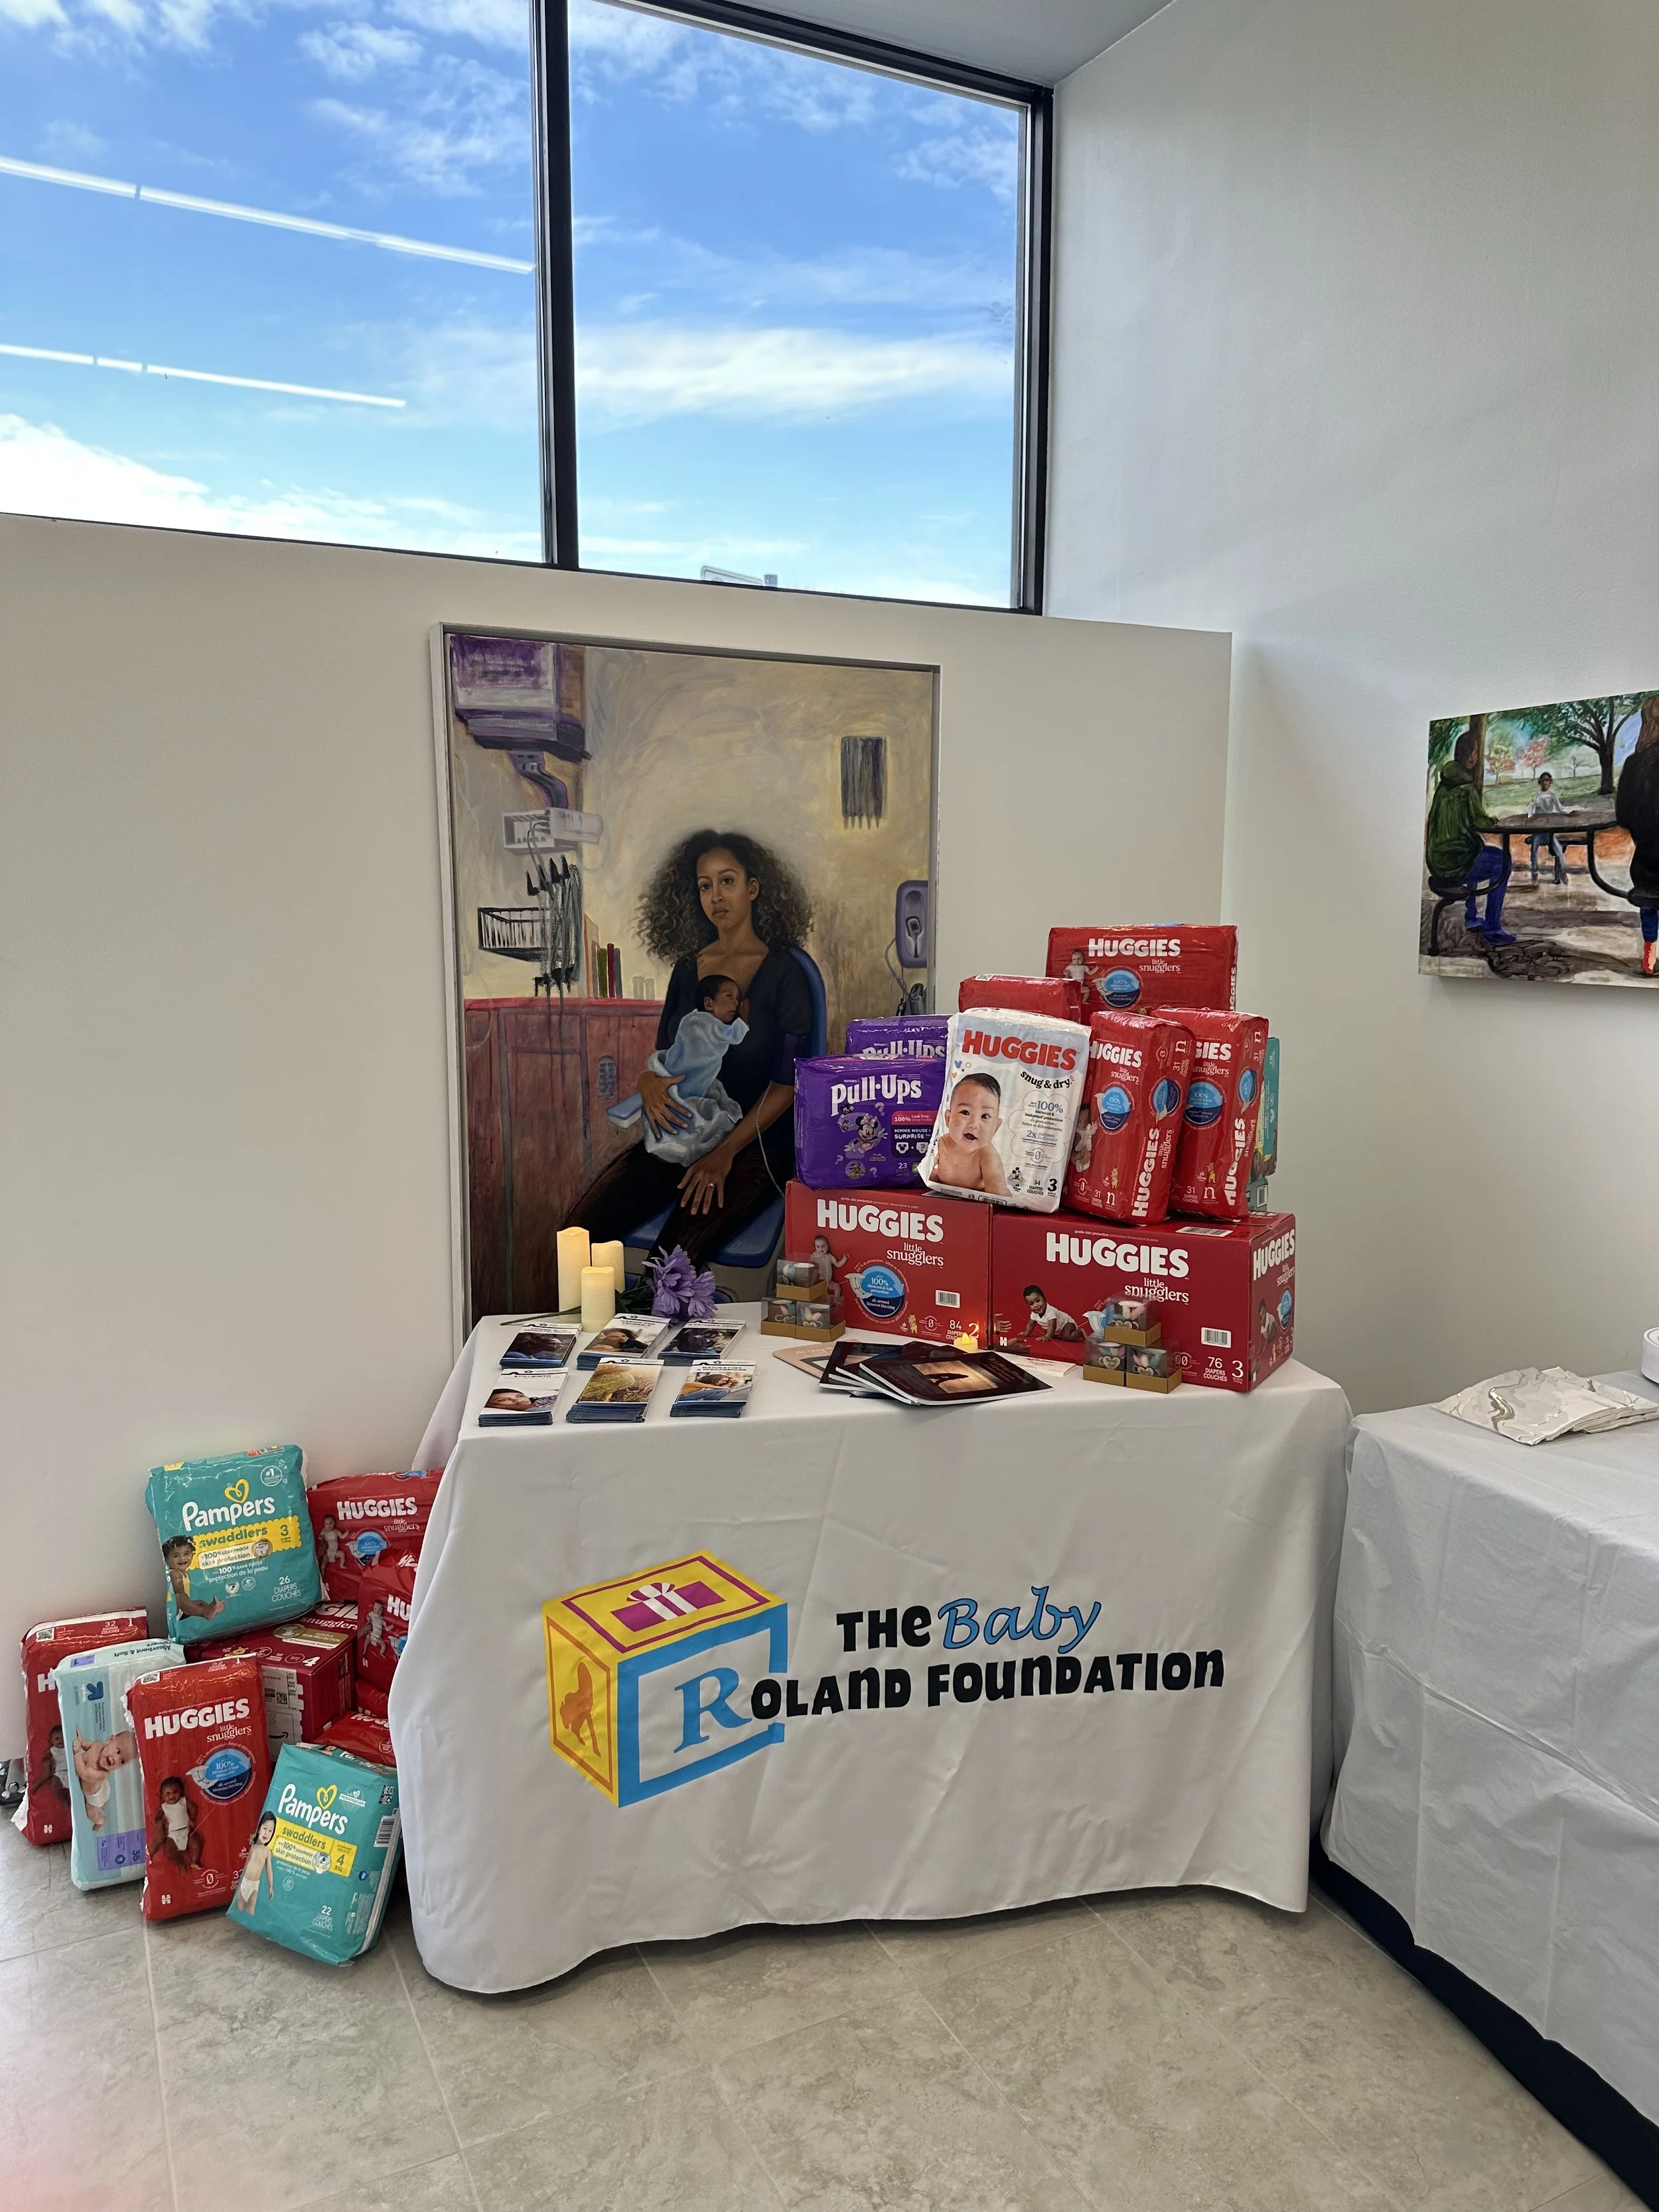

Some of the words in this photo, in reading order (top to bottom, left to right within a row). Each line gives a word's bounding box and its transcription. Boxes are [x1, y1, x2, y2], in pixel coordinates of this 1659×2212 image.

[1088, 938, 1181, 957] HUGGIES
[1139, 963, 1181, 974] snugglers
[962, 1030, 1077, 1070] HUGGIES
[1089, 1041, 1143, 1068] HUGGIES
[1195, 1041, 1232, 1061] GIES
[1173, 1062, 1181, 1071] 31
[1021, 1070, 1043, 1088] snug
[1044, 1080, 1052, 1089] &
[1054, 1078, 1071, 1089] dry
[1110, 1070, 1139, 1082] snugglers
[1037, 1100, 1063, 1113] 100%
[1161, 1130, 1174, 1169] snugglers
[1131, 1128, 1160, 1217] HUGGIES
[1047, 1178, 1058, 1192] 3
[1106, 1191, 1116, 1206] n
[1204, 1186, 1216, 1199] n
[817, 1199, 944, 1242] HUGGIES
[903, 1242, 922, 1253] little
[887, 1249, 944, 1266] snugglers
[1046, 1232, 1189, 1278] HUGGIES
[1253, 1229, 1295, 1281] HUGGIES
[871, 1277, 889, 1286] 100%
[1143, 1278, 1165, 1288] little
[1124, 1285, 1189, 1303] snugglers
[950, 1320, 962, 1331] 84
[968, 1323, 979, 1339] 2
[1208, 1357, 1223, 1368] 76
[1231, 1360, 1244, 1378] 3
[1203, 1373, 1228, 1382] COUCHES
[182, 1497, 275, 1531] Pampers
[336, 1497, 417, 1520] HUGGIES
[384, 1522, 420, 1532] snugglers
[198, 1526, 268, 1548] swaddlers
[280, 1524, 289, 1536] 3
[205, 1550, 222, 1560] 100%
[217, 1552, 251, 1566] protection
[209, 1571, 238, 1584] protection
[253, 1565, 269, 1575] peau
[218, 1566, 236, 1575] 100%
[279, 1576, 291, 1585] 26
[271, 1589, 302, 1603] COUCHES
[273, 1583, 298, 1595] DIAPERS
[127, 1618, 133, 1627] 1
[300, 1616, 358, 1631] snugglers
[937, 1585, 1102, 1653] Baby
[137, 1645, 171, 1654] Absorbent
[302, 1657, 321, 1666] 4
[927, 1649, 1225, 1708] FOUNDATION
[144, 1698, 250, 1739] HUGGIES
[207, 1726, 252, 1743] snugglers
[220, 1724, 234, 1733] little
[216, 1760, 234, 1770] 100%
[278, 1784, 348, 1834] Pampers
[282, 1827, 326, 1850] swaddlers
[283, 1841, 297, 1850] 100%
[133, 1849, 141, 1861] 35
[275, 1847, 285, 1856] skin
[285, 1851, 312, 1866] protection
[336, 1854, 345, 1866] 4
[321, 1905, 332, 1916] 22
[312, 1918, 334, 1931] COUCHES
[316, 1913, 333, 1925] DIAPERS
